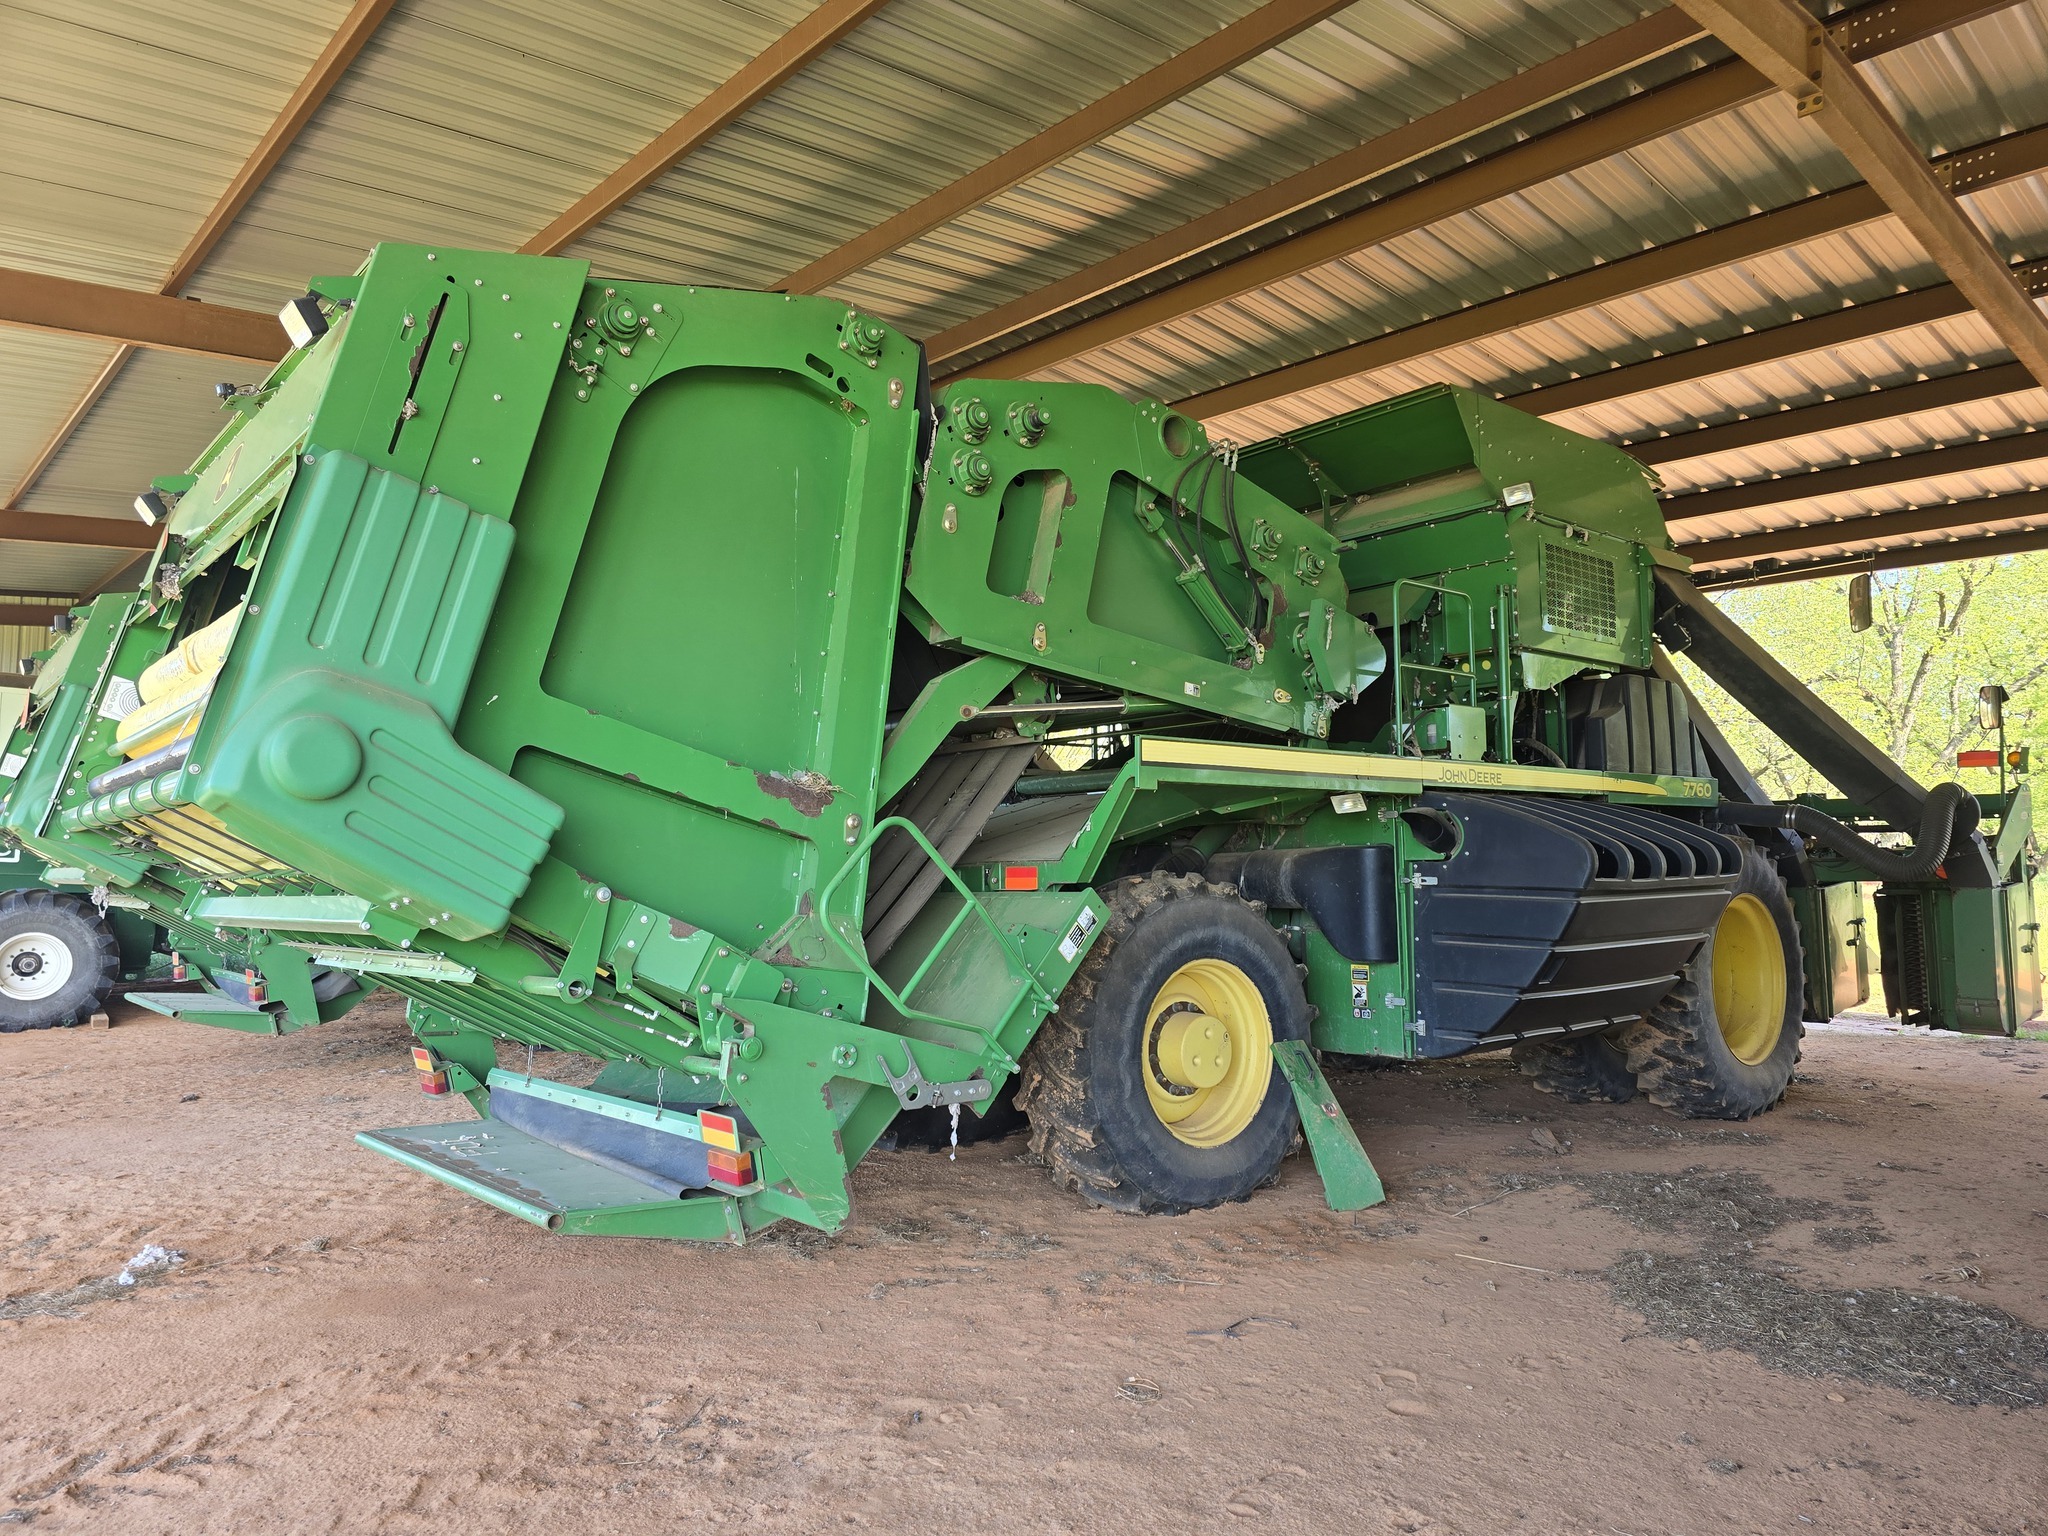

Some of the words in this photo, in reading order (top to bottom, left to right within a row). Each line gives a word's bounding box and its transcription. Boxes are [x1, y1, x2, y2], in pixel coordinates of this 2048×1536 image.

[1439, 767, 1467, 781] JOHN
[1469, 769, 1502, 784] DEERE
[1683, 782, 1712, 798] 7760
